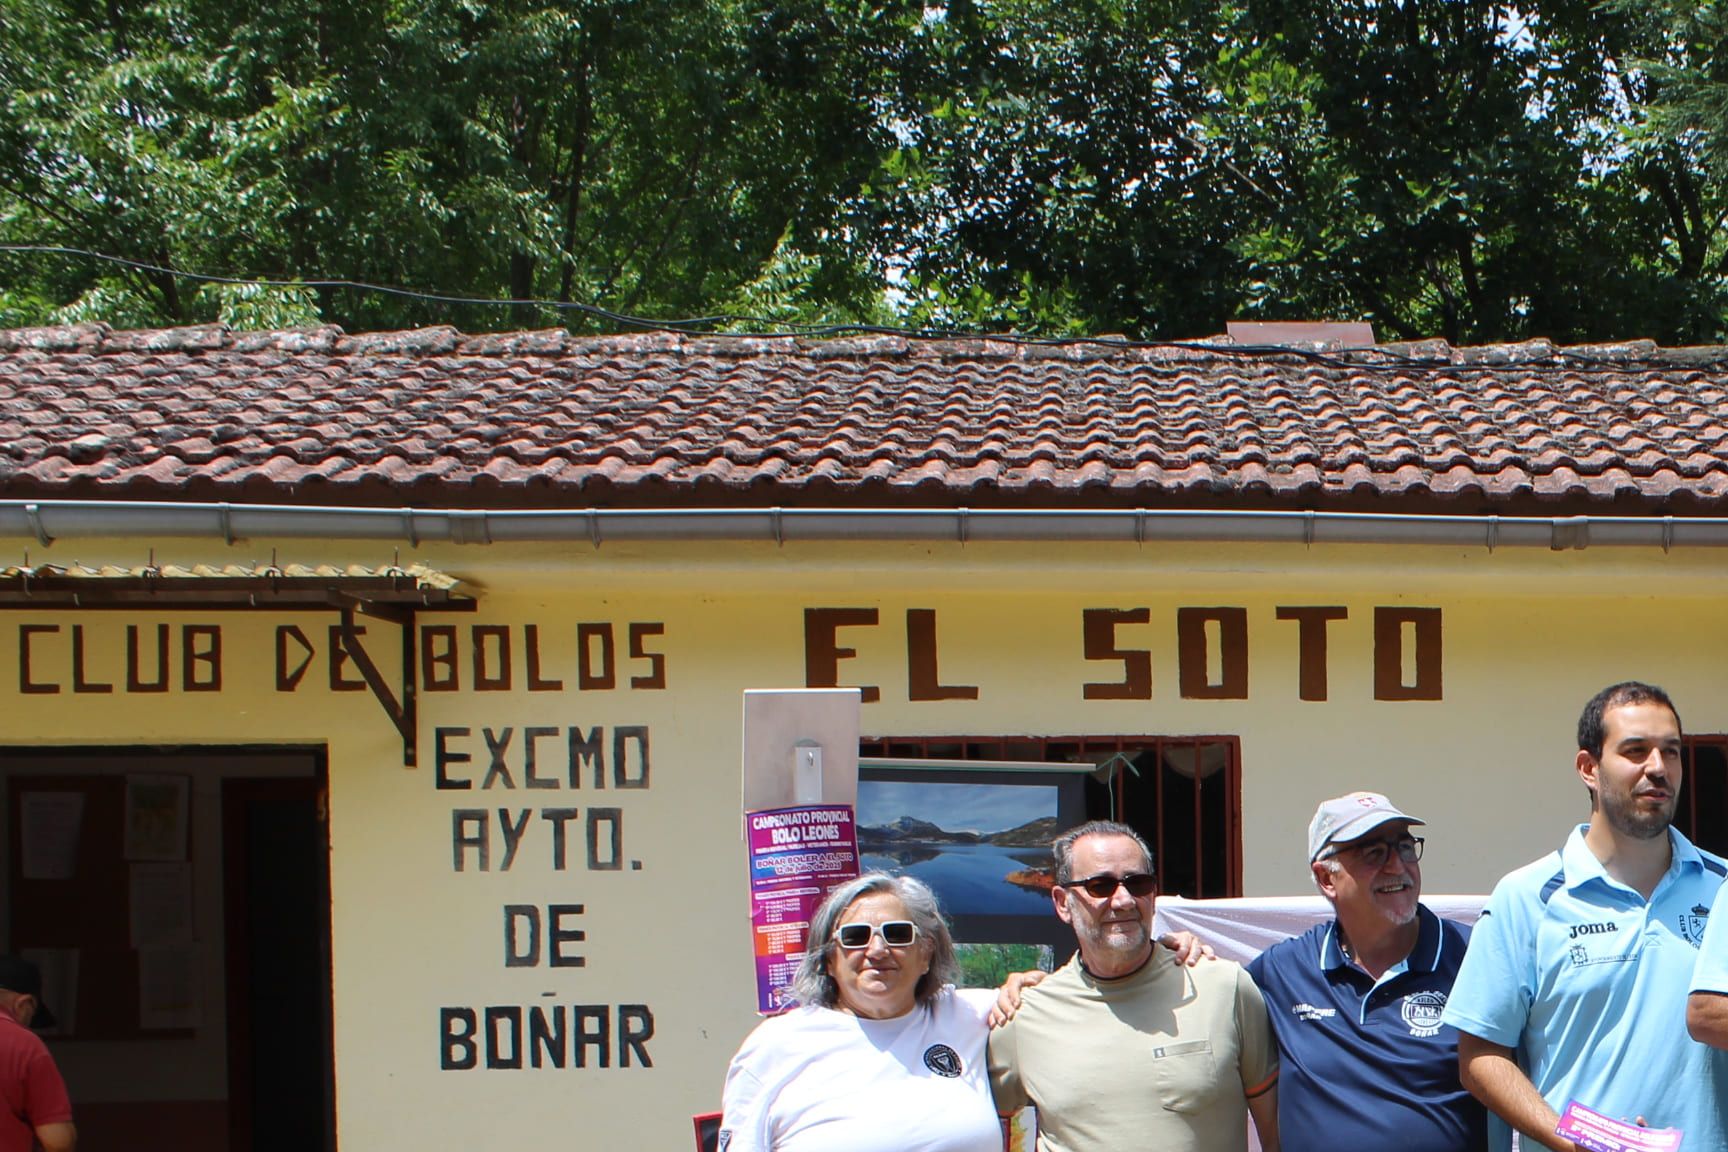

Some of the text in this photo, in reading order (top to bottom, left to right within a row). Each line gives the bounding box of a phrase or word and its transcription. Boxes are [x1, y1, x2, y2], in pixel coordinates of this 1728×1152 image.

[19, 623, 666, 693] CLUB DE BOLOS
[804, 606, 1443, 701] EL SOTO
[434, 726, 650, 790] EXCMO
[452, 808, 643, 872] AYTO.
[753, 810, 850, 830] CAMPEONATO PROVINCIAL
[772, 827, 801, 844] BOLO
[504, 904, 585, 968] DE
[440, 992, 655, 1070] BOÑAR
